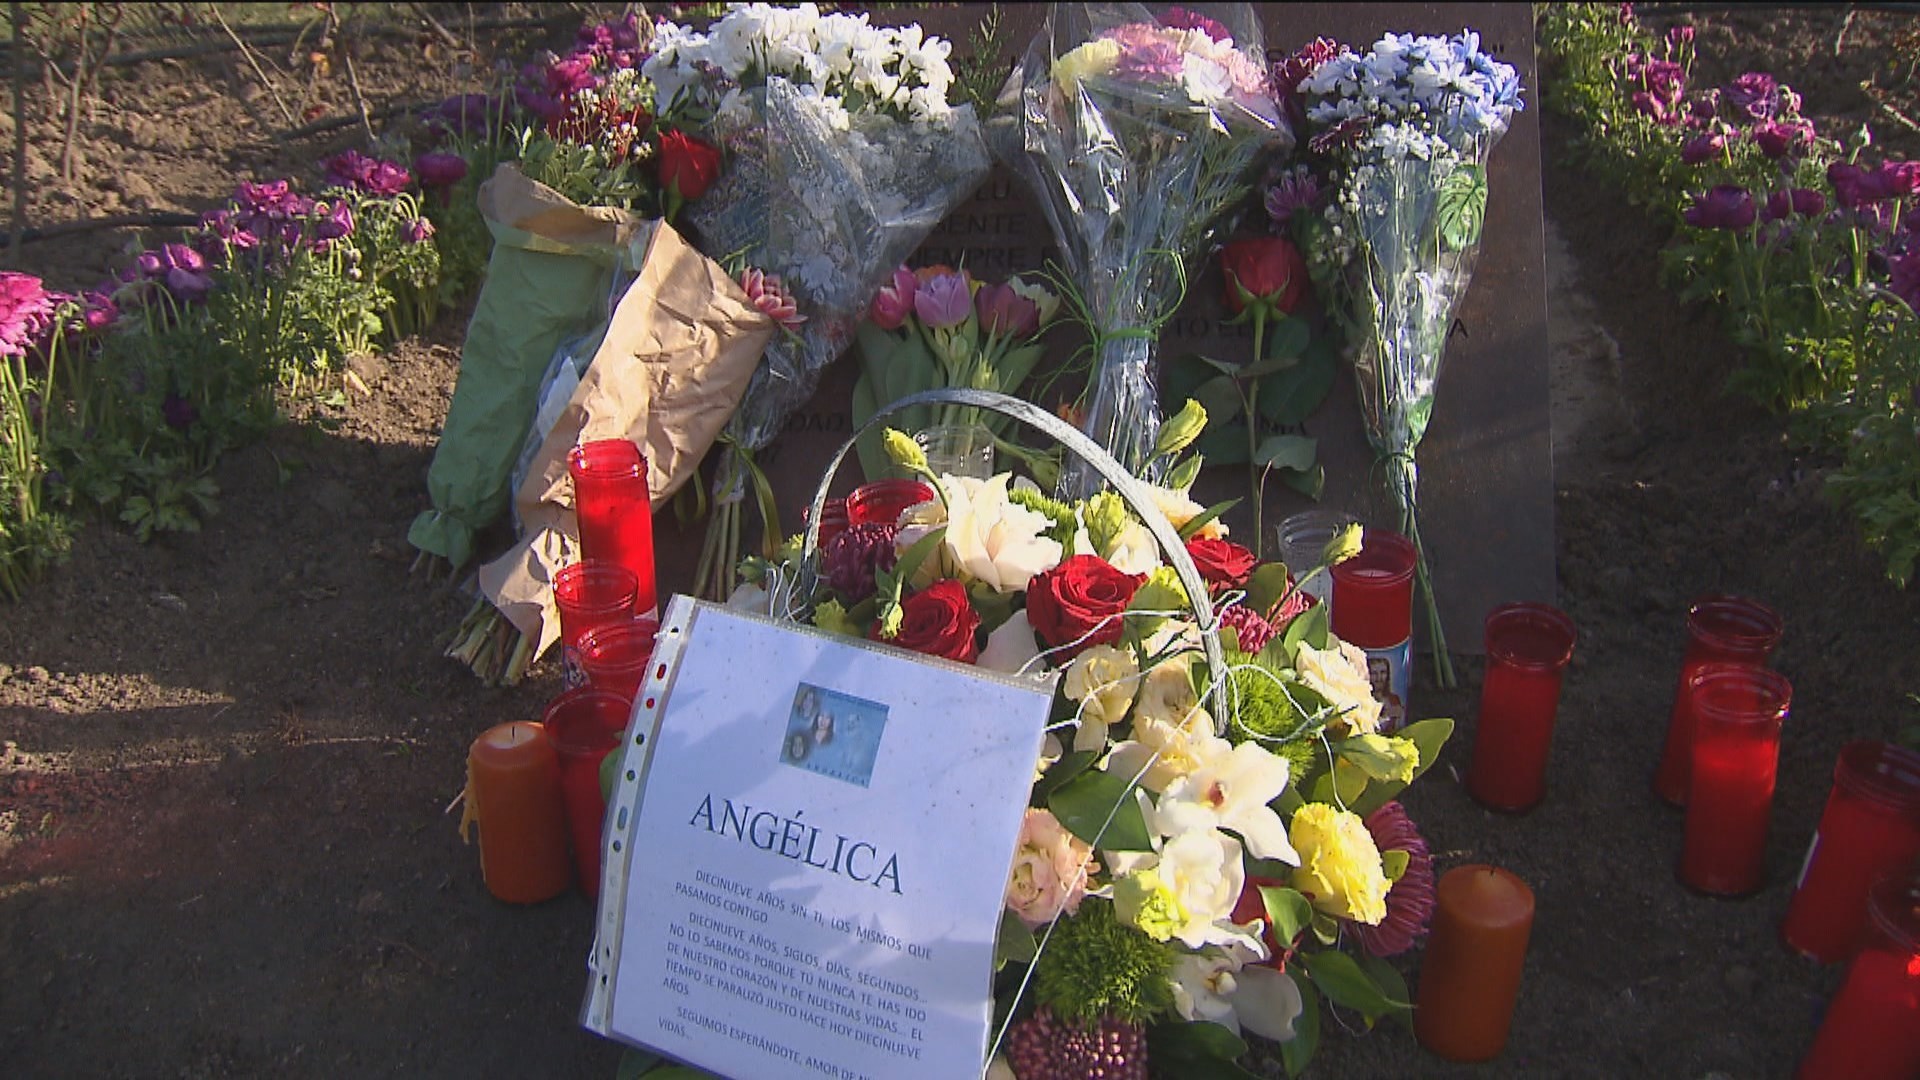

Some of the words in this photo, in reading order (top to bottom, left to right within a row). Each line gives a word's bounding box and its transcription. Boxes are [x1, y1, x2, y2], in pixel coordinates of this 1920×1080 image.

[689, 793, 904, 895] ANGÉLICA
[675, 882, 721, 907] PASAMOS
[723, 900, 769, 923] CONTIGO
[689, 912, 744, 941] DIECINUEVE
[696, 870, 752, 899] DIECINUEVE
[757, 891, 785, 911] AÑOS
[791, 903, 807, 919] SIN
[831, 917, 851, 933] LOS
[856, 926, 902, 951] MISMOS
[908, 944, 932, 960] QUE
[663, 978, 689, 996] AÑOS
[666, 959, 701, 981] TIEMPO
[703, 973, 715, 986] SE
[765, 1000, 797, 1017] JUSTO
[800, 1010, 826, 1029] HACE
[830, 1021, 852, 1037] HOY
[855, 1030, 921, 1059] DIECINUEVE
[667, 942, 679, 955] DE
[683, 947, 727, 972] NUESTRO
[730, 963, 778, 991] CORAZÓN
[779, 983, 788, 995] Y
[790, 985, 803, 1001] DE
[807, 994, 861, 1021] NUESTRAS
[911, 1028, 923, 1041] EL
[669, 923, 684, 938] NO
[688, 930, 700, 943] LO
[704, 936, 750, 961] SABEMOS
[754, 955, 796, 979] PORQUE
[818, 977, 856, 1001] NUNCA
[860, 993, 872, 1006] TE
[878, 998, 901, 1014] HAS
[905, 1008, 927, 1022] IDO
[677, 1007, 728, 1035] SEGUIMOS
[805, 1056, 839, 1077] AMOR
